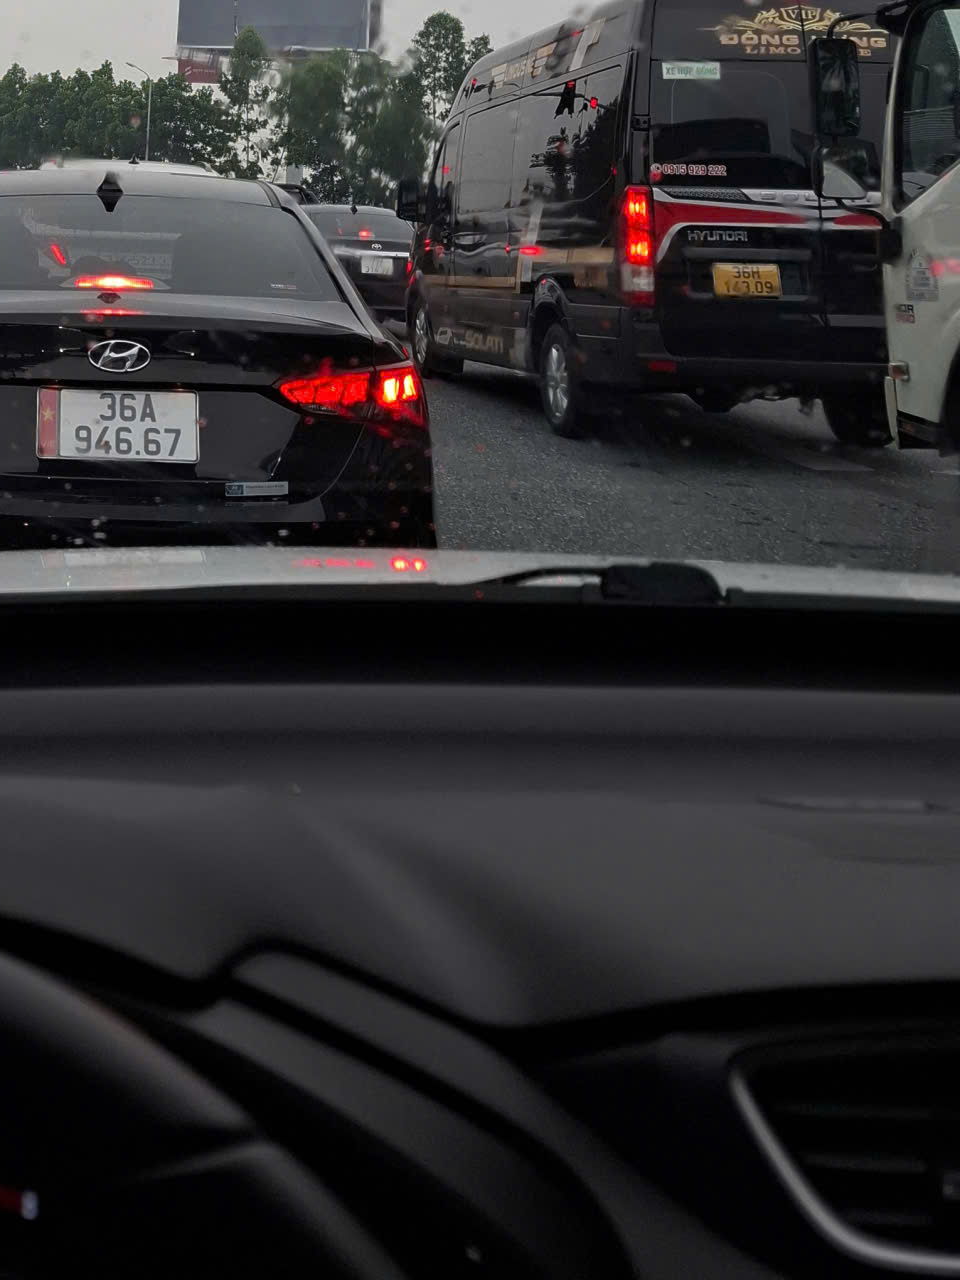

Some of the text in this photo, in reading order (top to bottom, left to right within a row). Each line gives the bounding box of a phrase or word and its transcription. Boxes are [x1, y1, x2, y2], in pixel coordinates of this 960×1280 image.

[787, 8, 818, 20] VIP
[665, 66, 676, 76] XE
[662, 164, 727, 176] 0915 929 222
[687, 230, 748, 242] HYUNDAI
[733, 266, 760, 279] 36H
[99, 392, 157, 423] 36A
[74, 425, 182, 457] 946.67
[21, 1190, 38, 1220] 8
